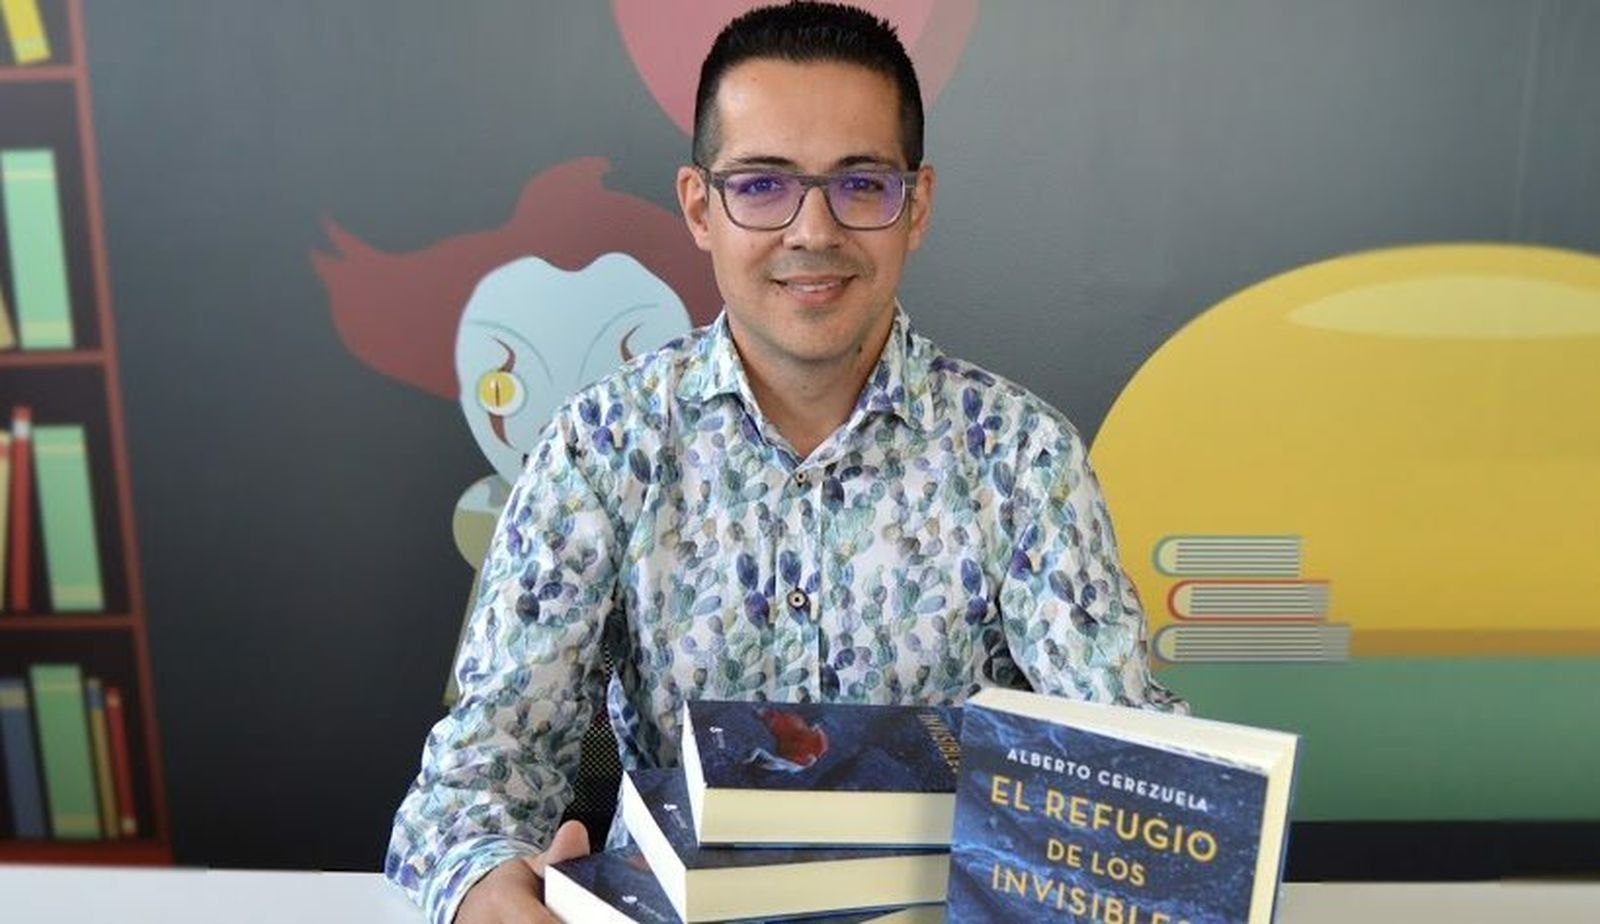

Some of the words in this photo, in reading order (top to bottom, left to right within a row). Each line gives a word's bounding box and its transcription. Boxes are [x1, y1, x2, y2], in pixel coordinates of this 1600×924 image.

[1006, 749, 1091, 780] ALBERTO
[1098, 771, 1207, 811] CEREZUELA
[991, 776, 1030, 811] EL
[1045, 790, 1217, 861] REFUGIO
[1046, 838, 1081, 868] DE
[1092, 851, 1146, 886] LOS
[992, 865, 1192, 924] INVISIBL
